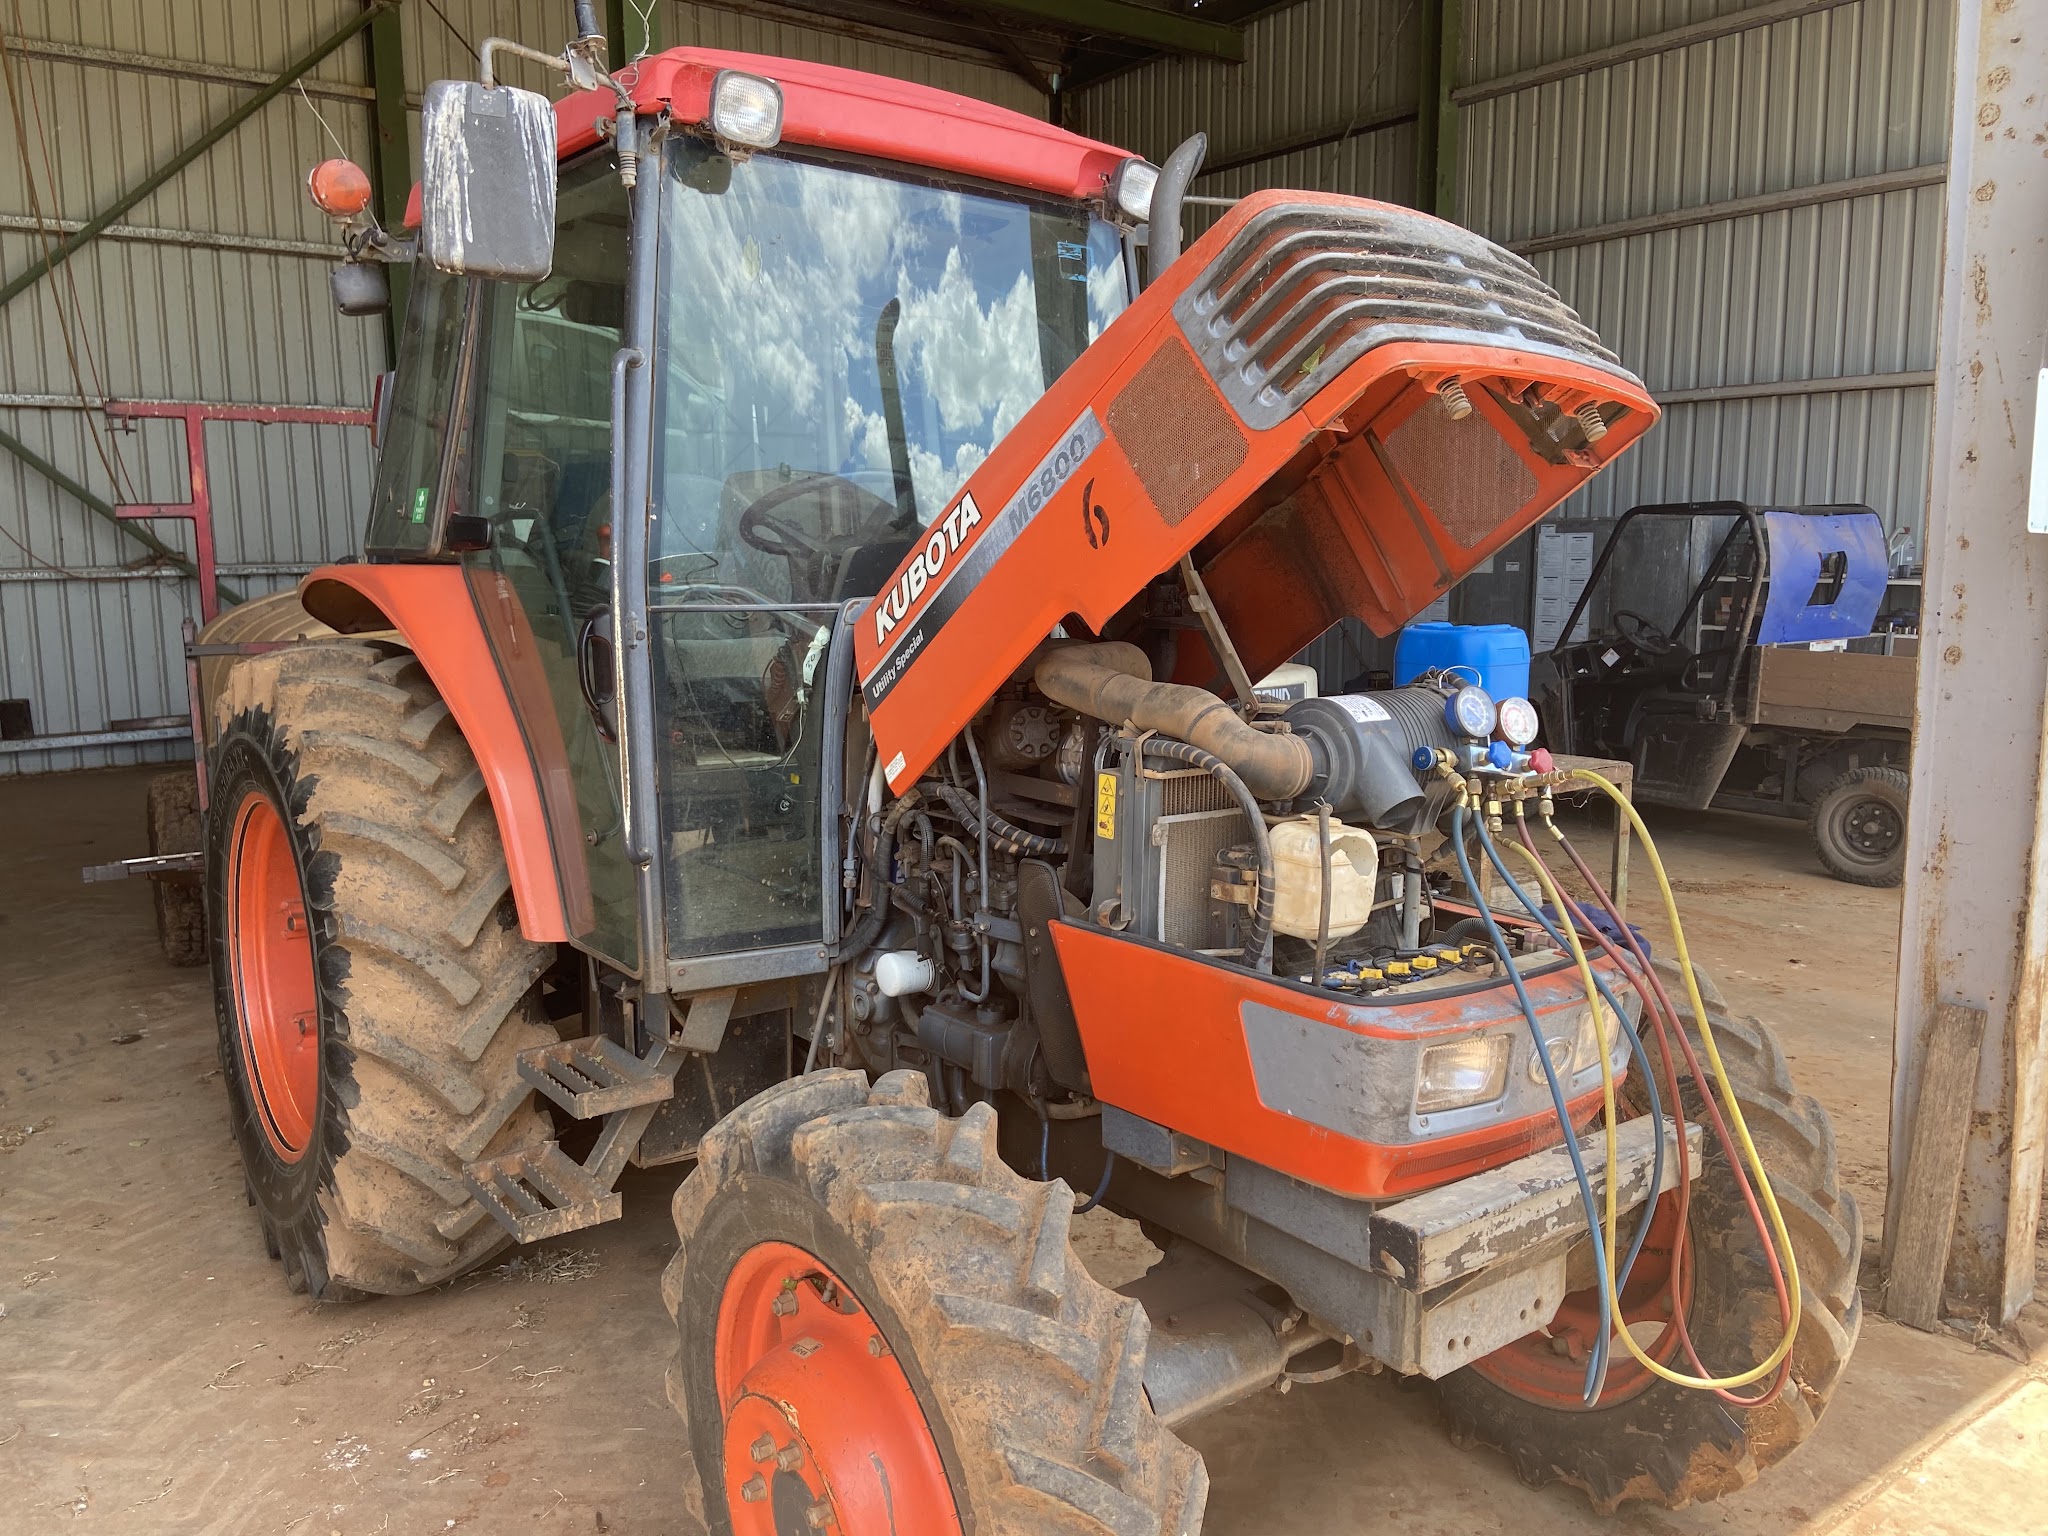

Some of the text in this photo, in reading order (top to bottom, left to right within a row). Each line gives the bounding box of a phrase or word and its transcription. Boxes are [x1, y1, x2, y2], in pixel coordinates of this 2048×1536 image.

[1008, 433, 1086, 535] M6800
[874, 490, 983, 647] KUBOTA
[872, 628, 924, 699] Utility Special
